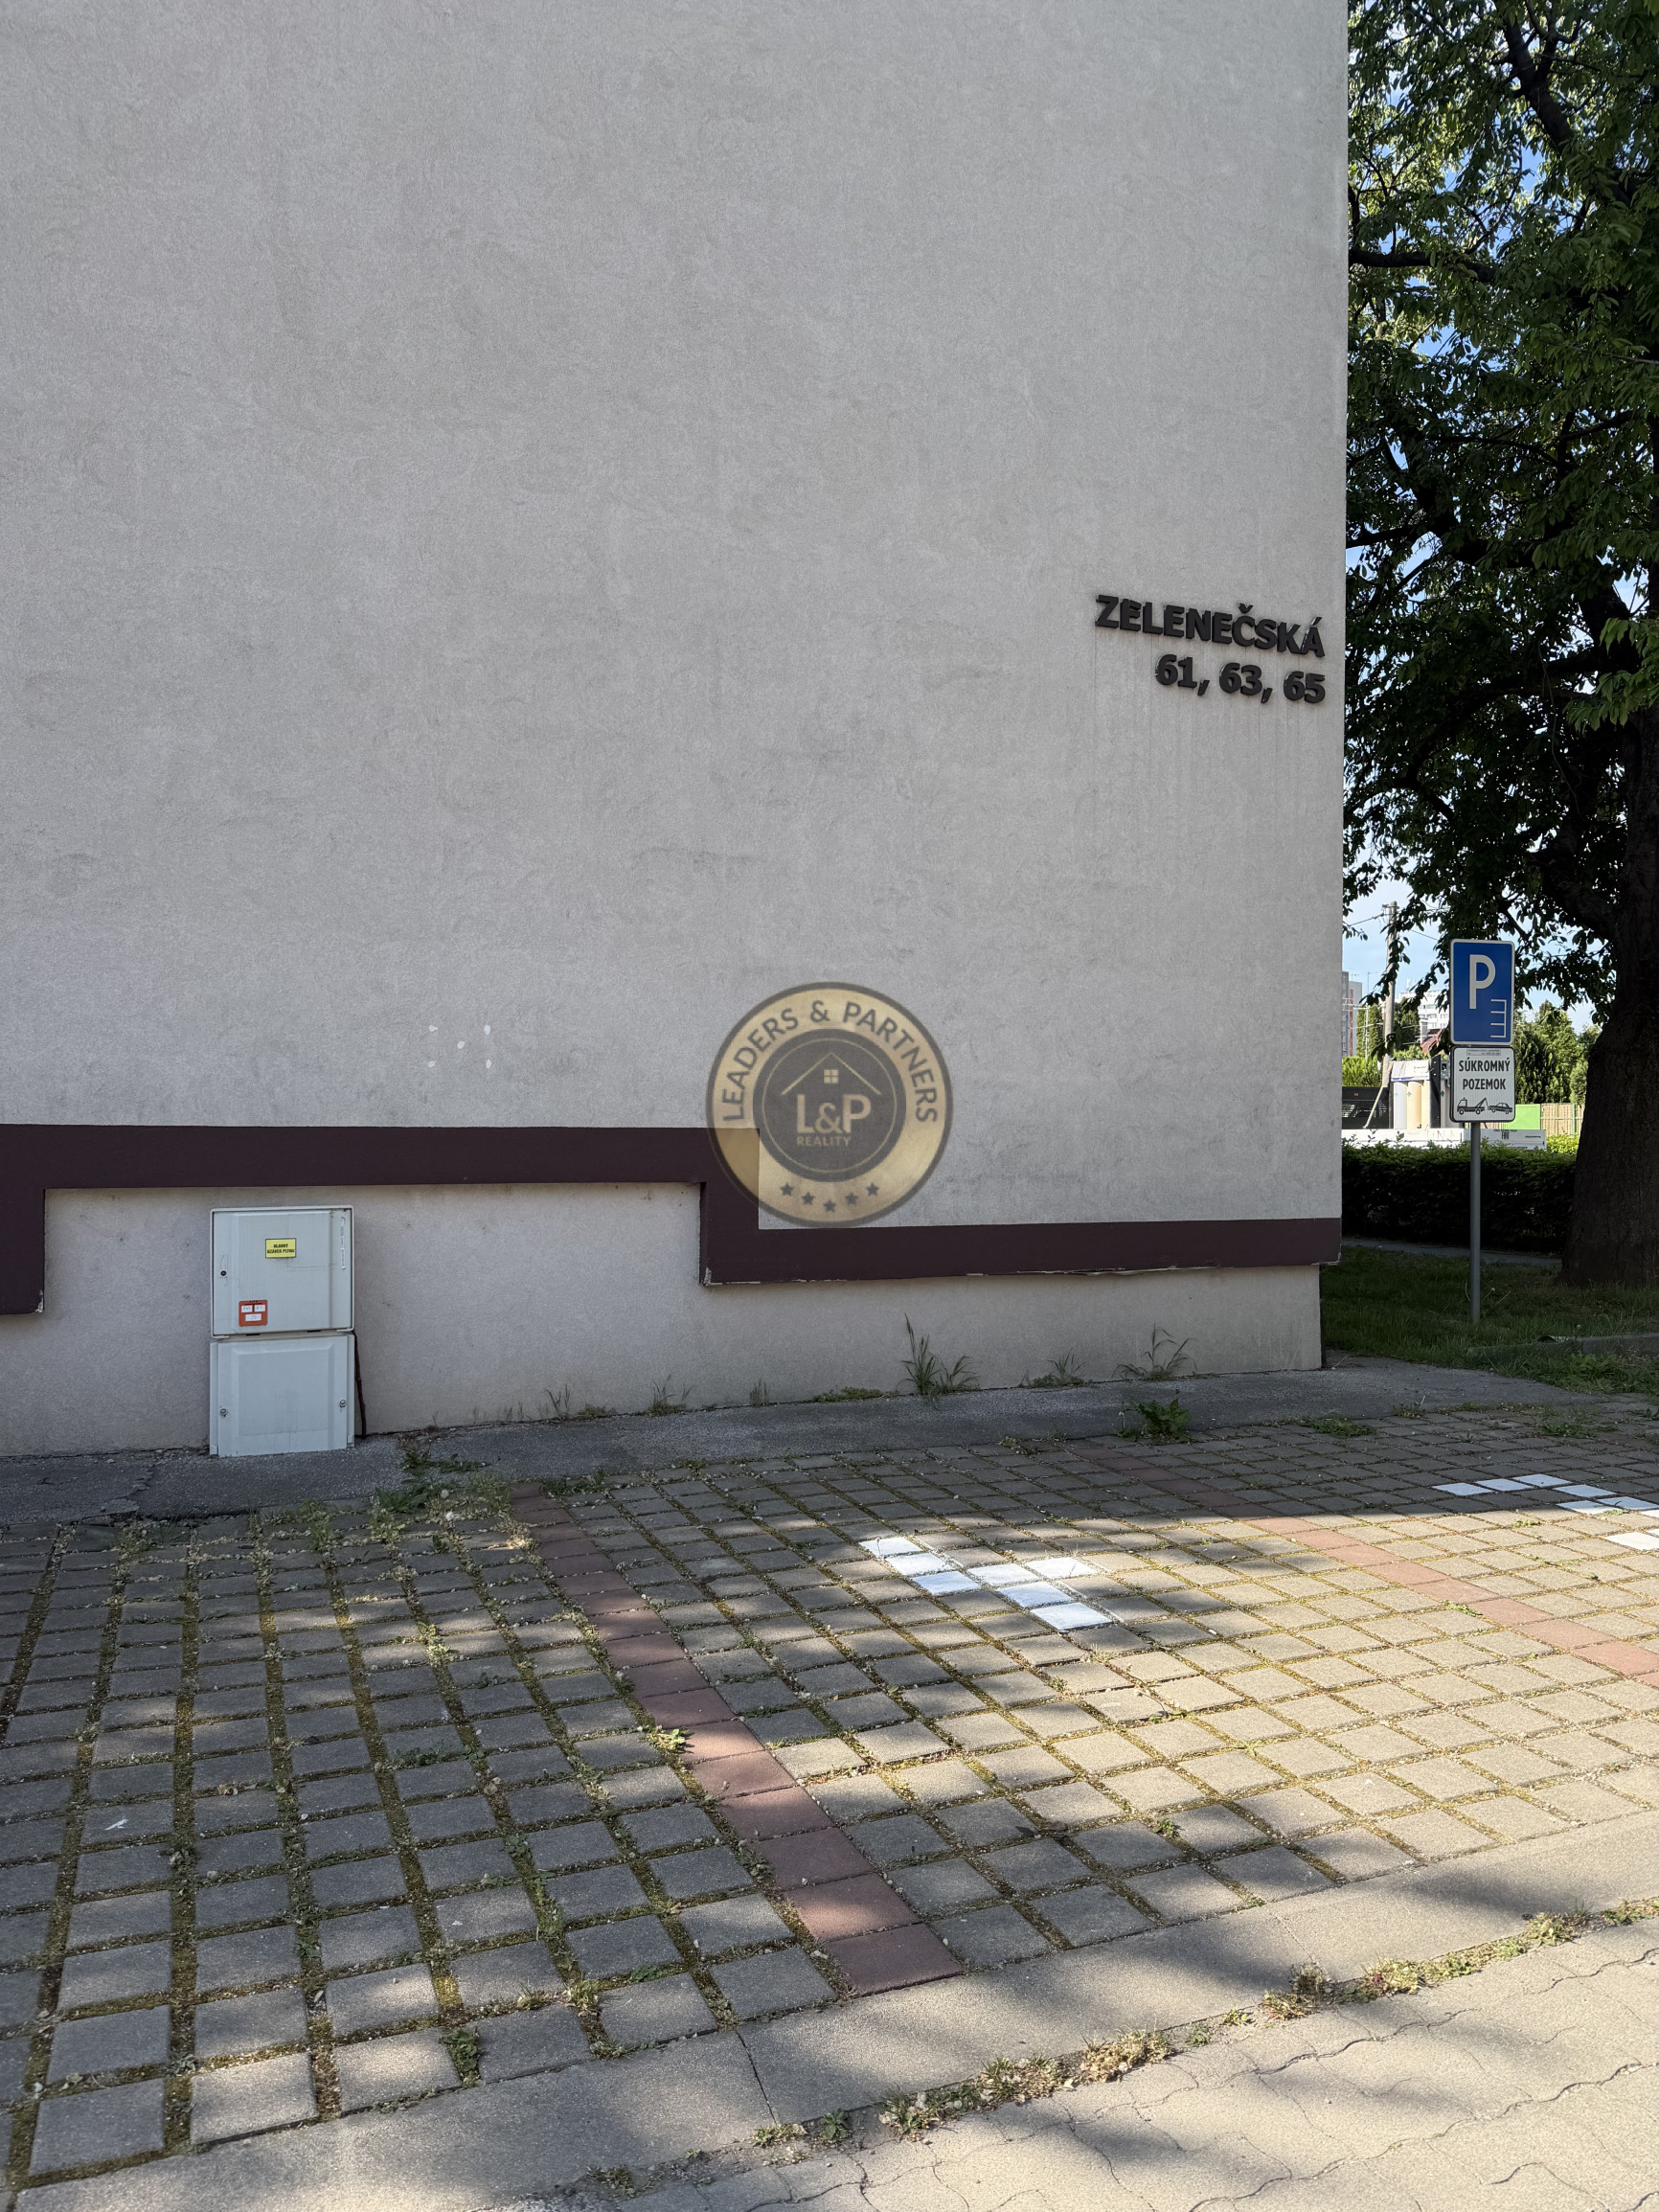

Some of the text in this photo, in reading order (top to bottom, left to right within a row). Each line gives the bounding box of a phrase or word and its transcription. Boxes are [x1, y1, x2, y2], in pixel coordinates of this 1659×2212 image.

[1095, 594, 1326, 657] ZELENEČSKÁ
[1155, 654, 1326, 703] 61, 63, 65
[1469, 954, 1496, 1009] P
[1459, 1057, 1511, 1072] SÚKROMNÝ
[1463, 1079, 1507, 1090] POZEMOK
